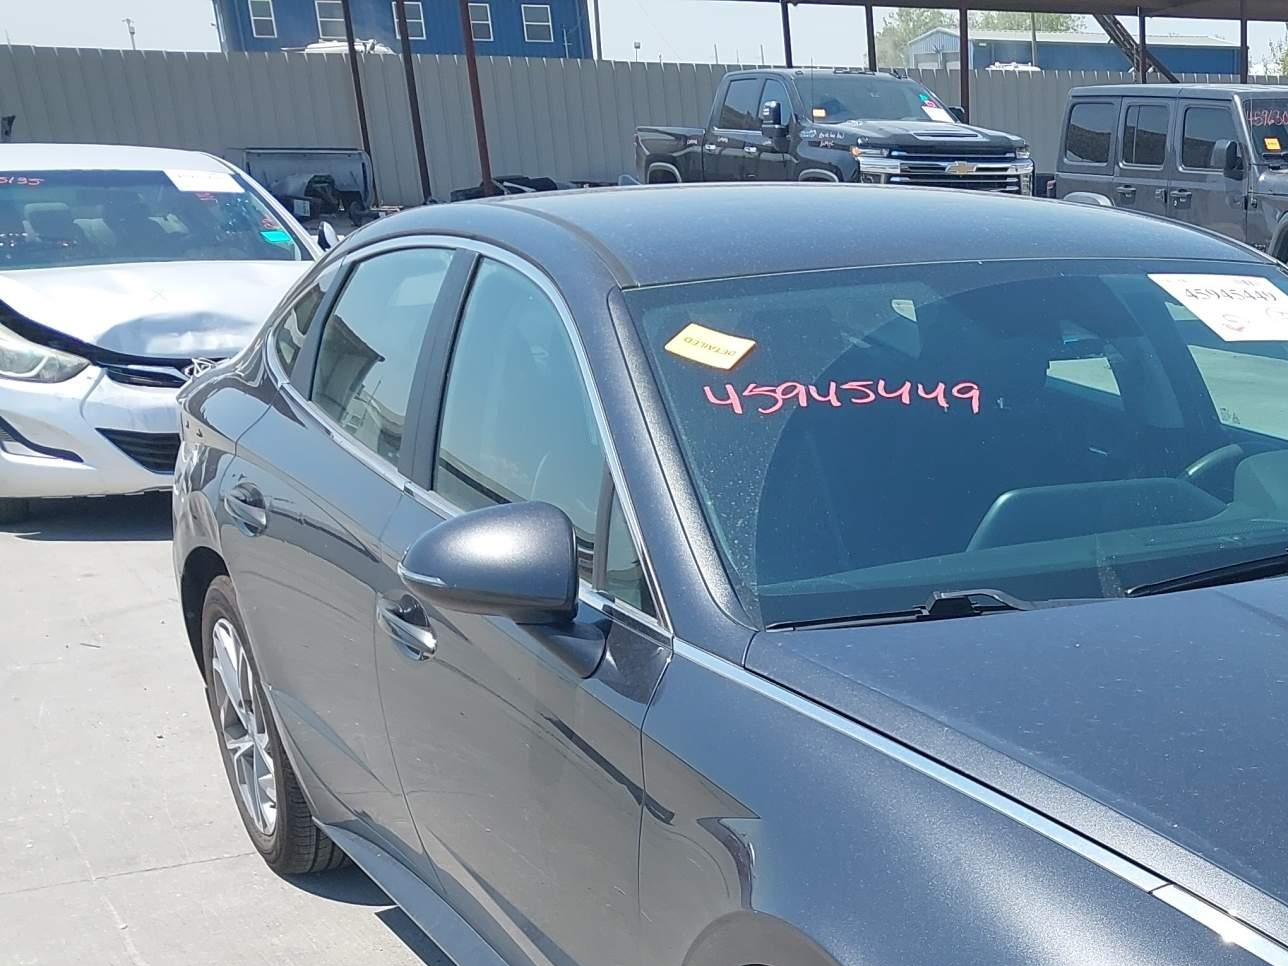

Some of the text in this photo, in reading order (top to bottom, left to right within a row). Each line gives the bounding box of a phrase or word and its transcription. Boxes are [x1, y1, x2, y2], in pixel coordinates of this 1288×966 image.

[1184, 287, 1278, 302] 45945449
[683, 336, 737, 357] DETAILED
[703, 379, 980, 415] 45945449
